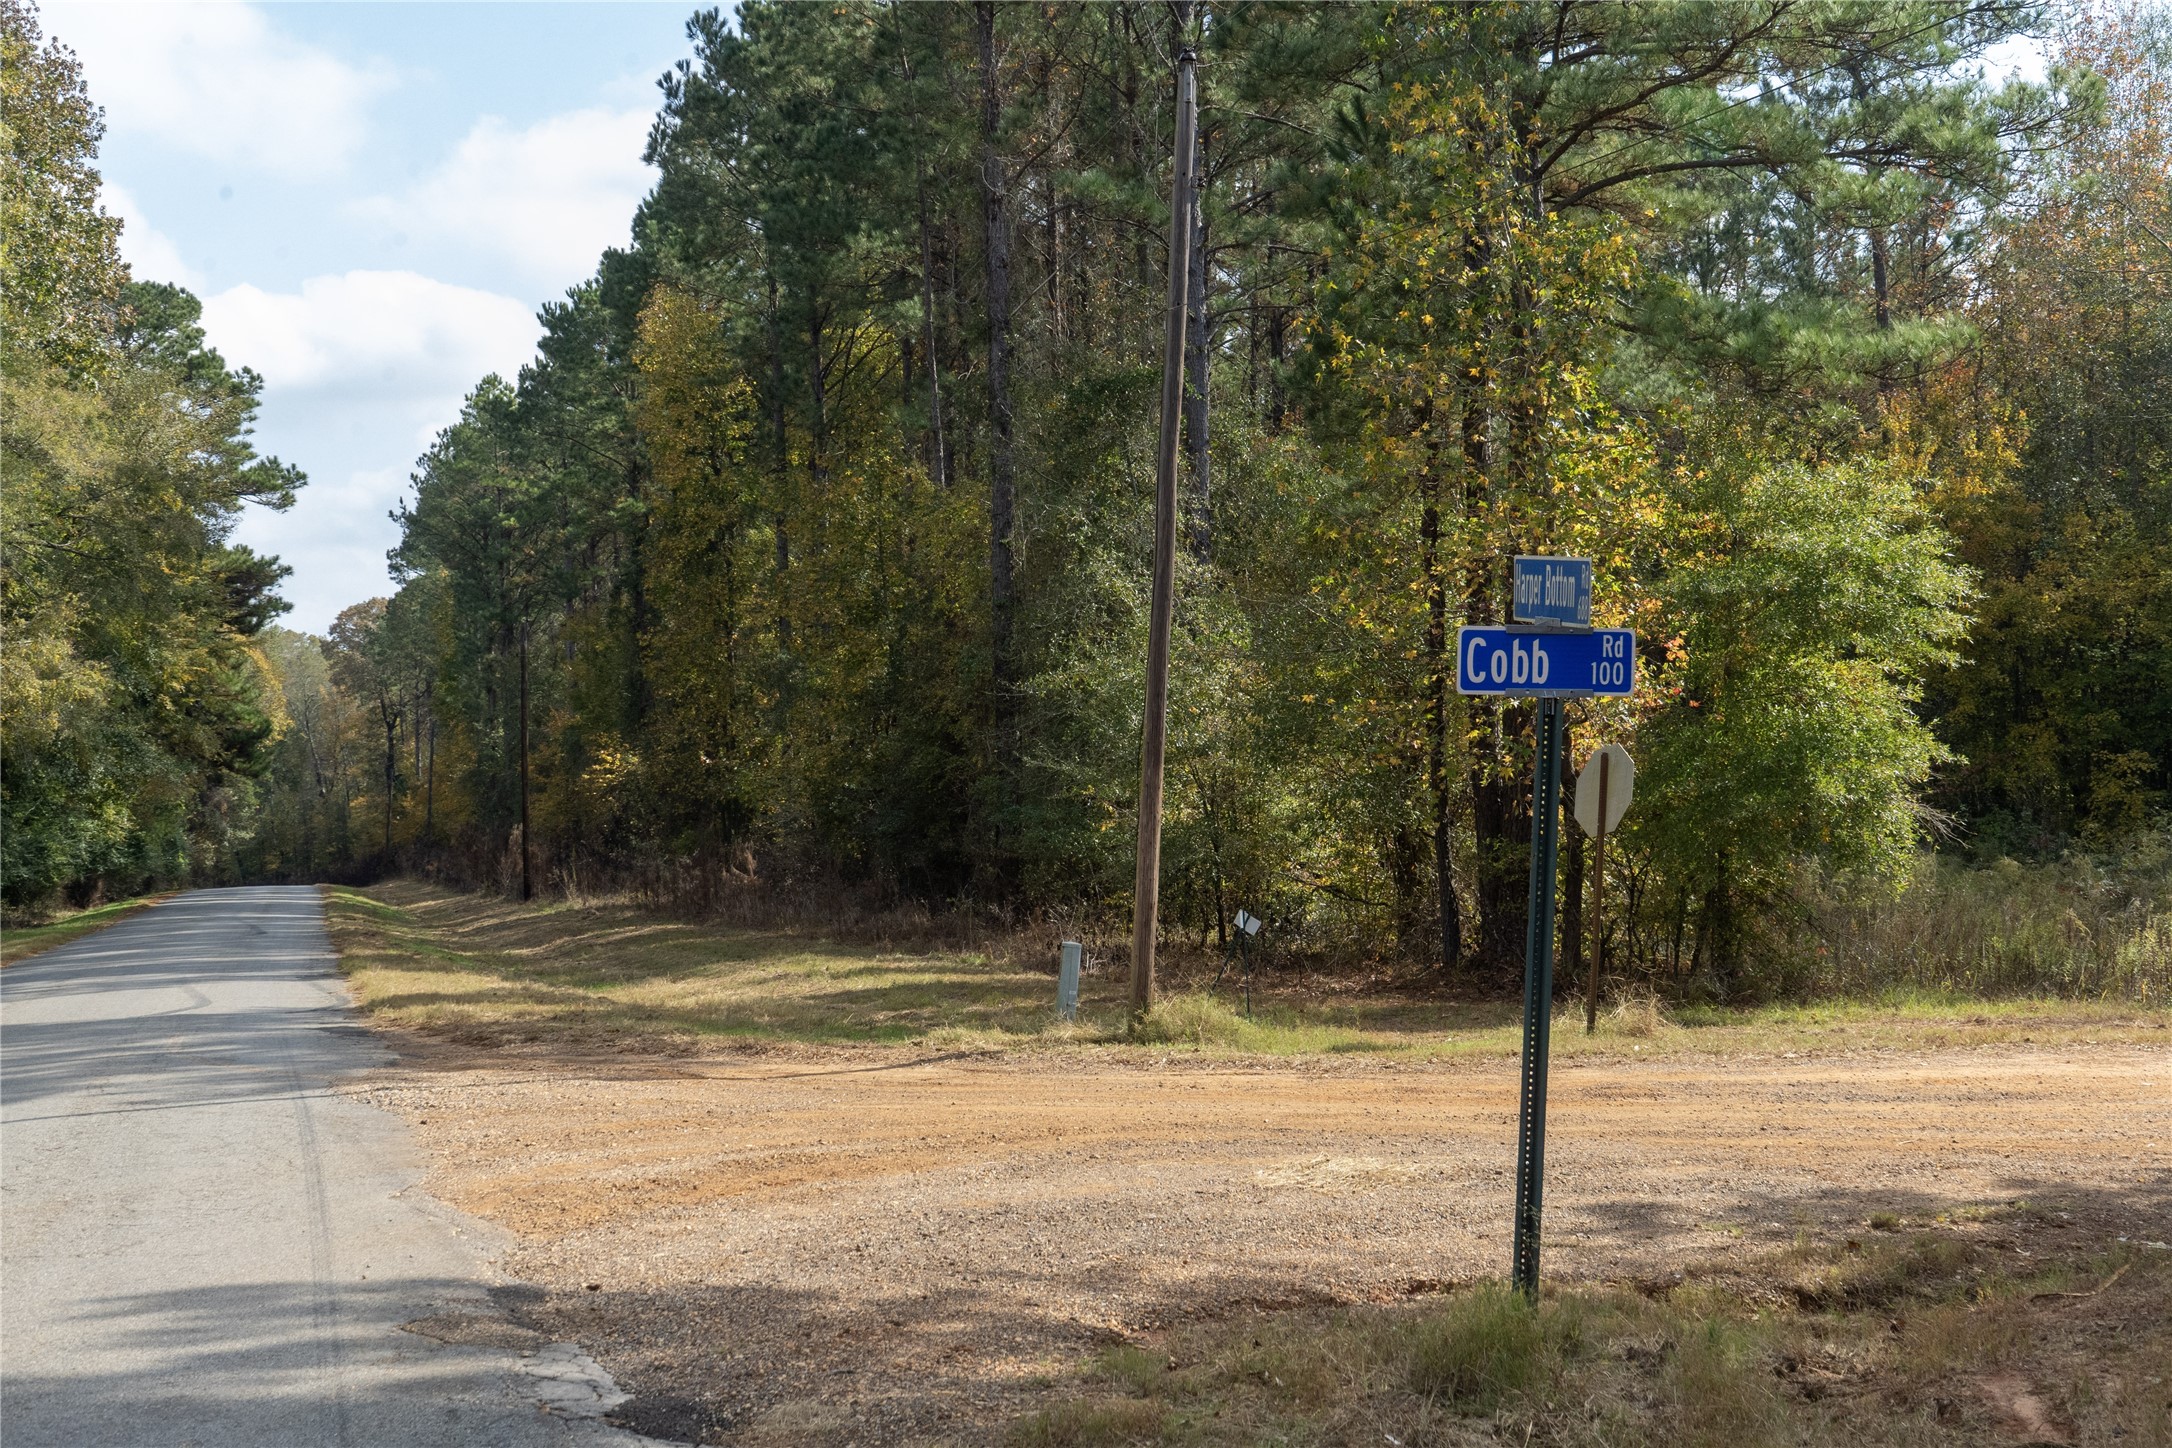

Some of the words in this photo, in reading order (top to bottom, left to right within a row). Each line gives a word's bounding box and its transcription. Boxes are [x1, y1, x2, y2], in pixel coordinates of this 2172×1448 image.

[1515, 563, 1542, 614] Harper
[1545, 564, 1576, 608] Bottom
[1581, 564, 1590, 590] Rd
[1602, 634, 1624, 658] Rd
[1466, 637, 1550, 684] Cobb
[1591, 662, 1624, 686] 100
